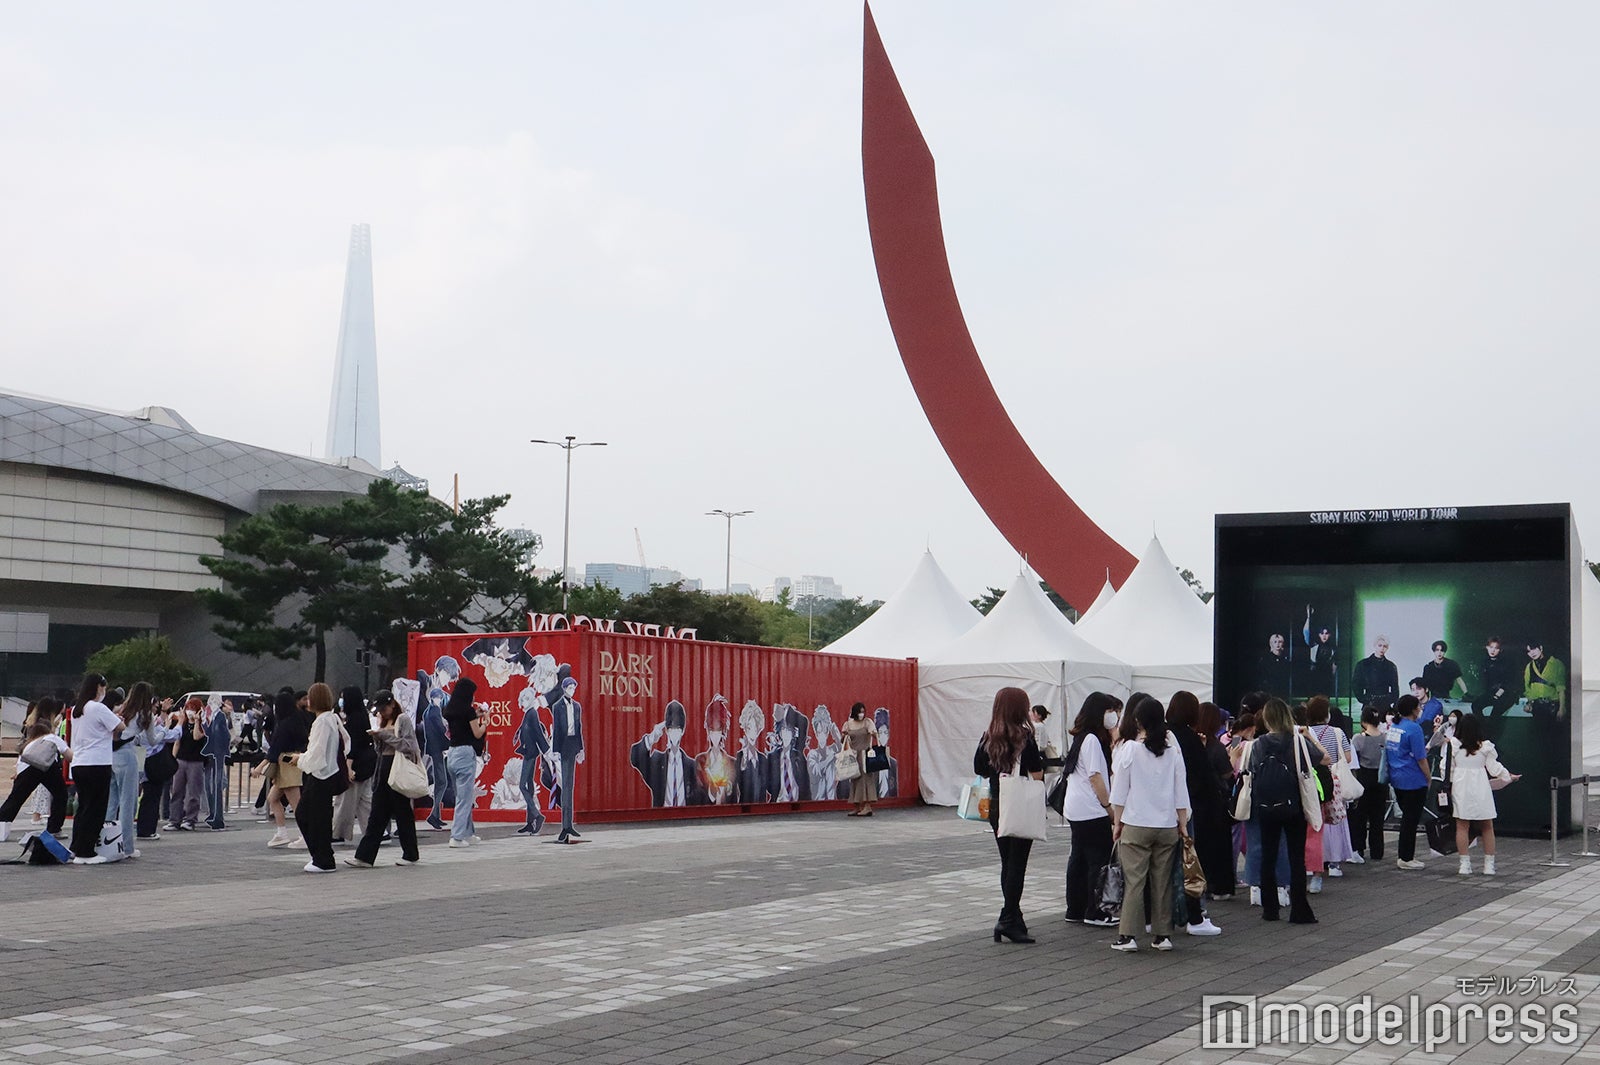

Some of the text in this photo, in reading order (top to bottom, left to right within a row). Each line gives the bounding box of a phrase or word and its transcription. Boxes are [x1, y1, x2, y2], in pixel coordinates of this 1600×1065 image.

[1309, 507, 1459, 524] STRAY KIDS 2ND WORLD TOUR
[599, 650, 654, 675] DARK
[599, 674, 654, 698] MOON
